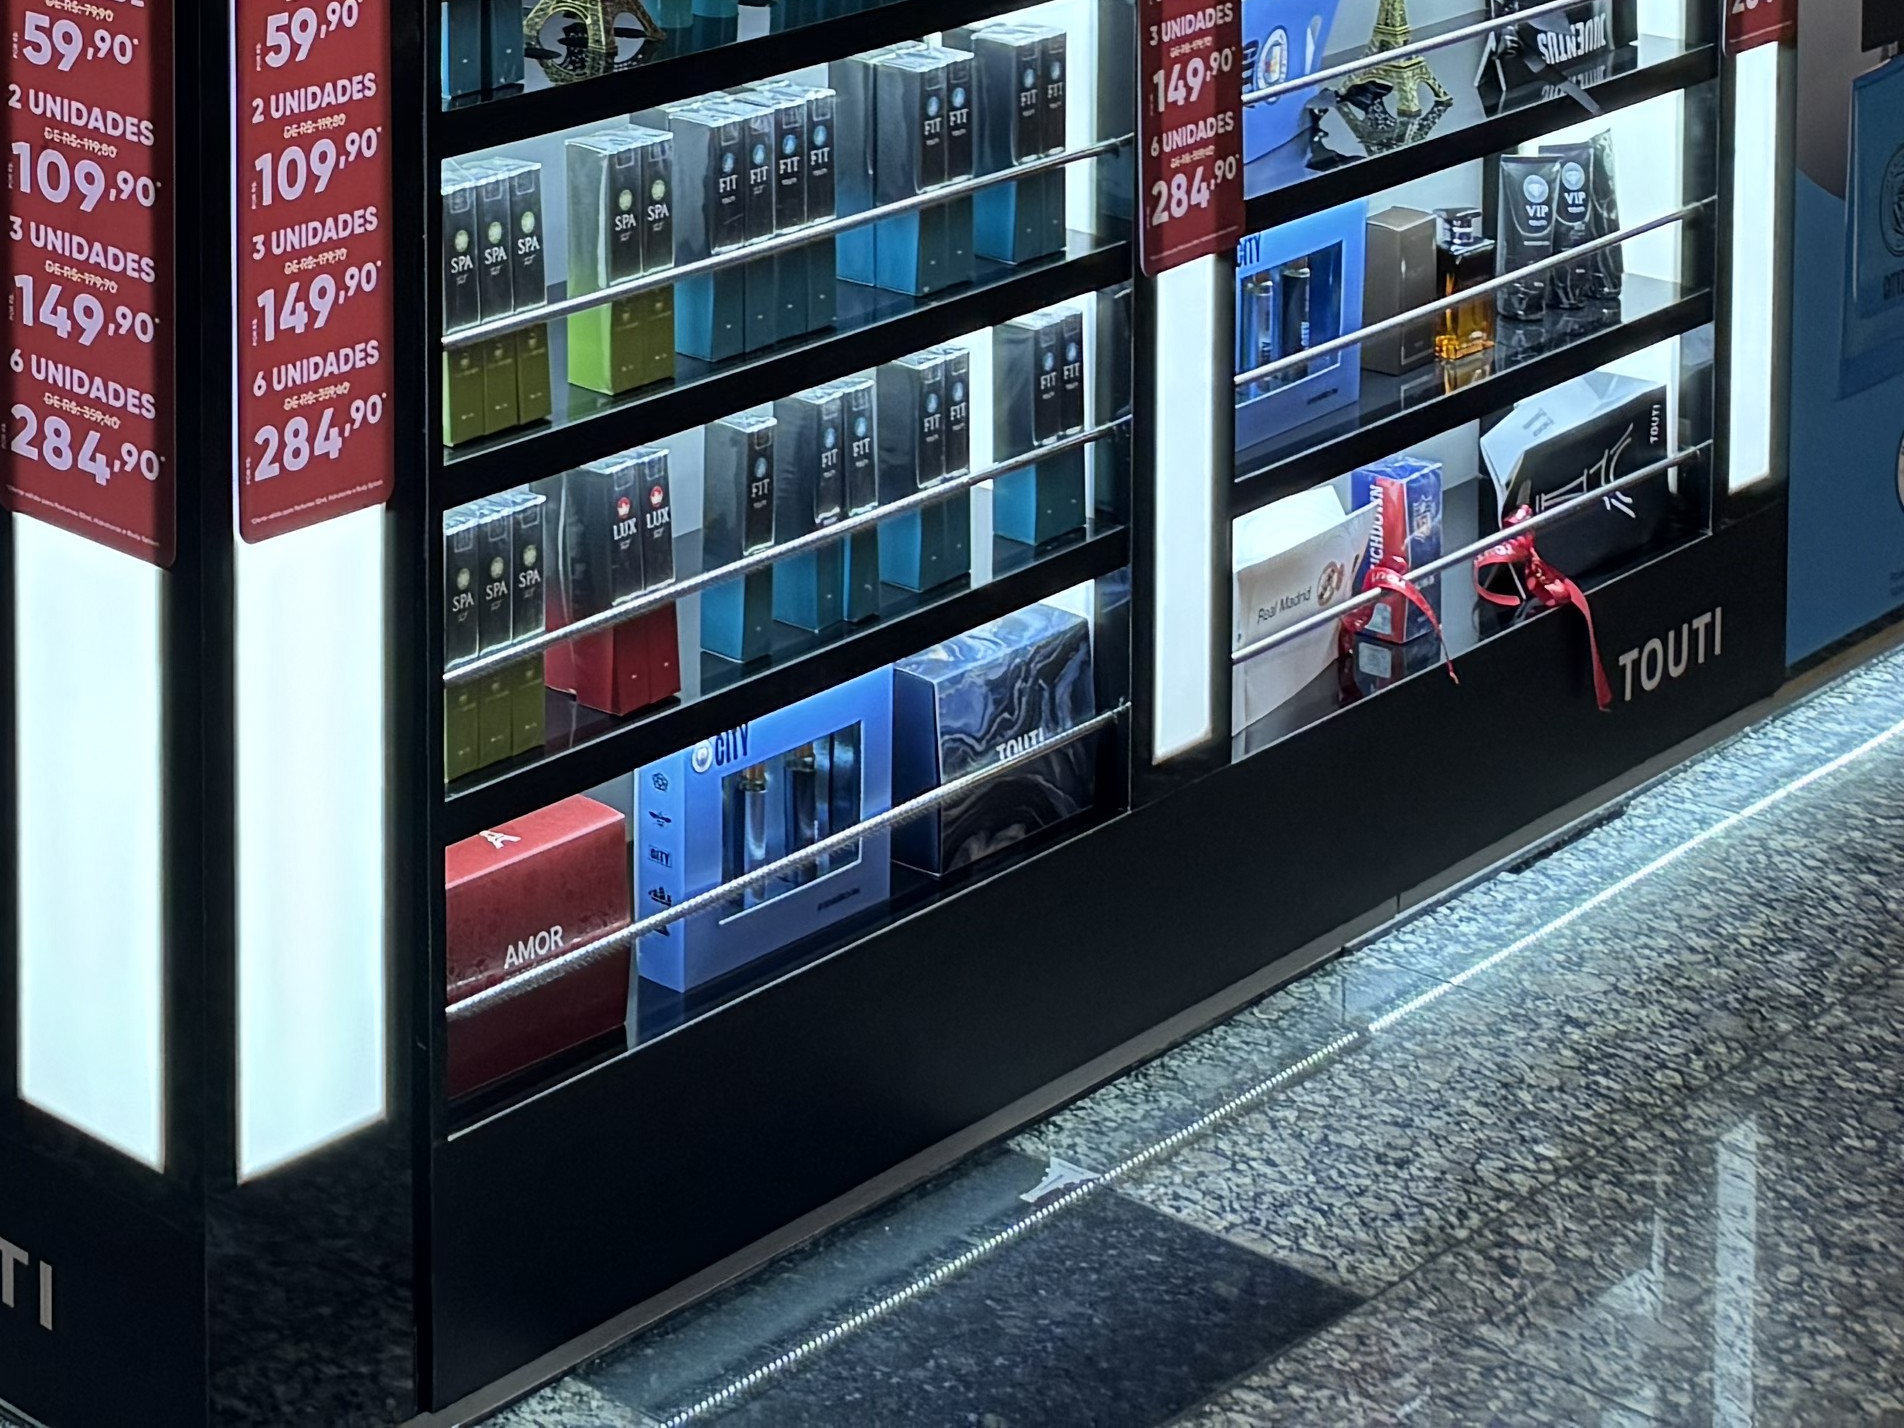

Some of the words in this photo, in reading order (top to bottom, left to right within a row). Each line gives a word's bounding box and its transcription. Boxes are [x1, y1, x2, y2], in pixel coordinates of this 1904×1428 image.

[1149, 26, 1159, 46] 3
[1161, 3, 1233, 43] UNIDADES
[1538, 13, 1607, 65] JUVENTUS
[8, 84, 22, 110] 2
[29, 89, 154, 147] UNIDADES
[251, 99, 265, 125] 2
[270, 72, 377, 119] UNIDADES
[1020, 88, 1038, 108] FIT
[1150, 136, 1159, 157] 6
[1163, 111, 1234, 154] UNIDADES
[779, 155, 800, 176] FIT
[1525, 204, 1550, 219] VIP
[1564, 191, 1586, 207] VIP
[252, 235, 265, 260] 3
[271, 206, 378, 255] UNIDADES
[614, 212, 637, 231] SPA
[8, 215, 23, 240] 3
[30, 221, 156, 283] UNIDADES
[9, 348, 24, 372] 6
[31, 353, 156, 420] UNIDADES
[253, 370, 266, 397] 6
[272, 339, 379, 391] UNIDADES
[1039, 370, 1057, 391] FIT
[1650, 403, 1661, 445] TOUTI
[821, 448, 840, 469] FIT
[613, 518, 638, 541] LUX
[645, 506, 670, 529] LUX
[518, 568, 542, 588] SPA
[1257, 603, 1277, 624] Real
[1279, 587, 1312, 613] Madrid
[1617, 606, 1723, 702] TOUTI
[714, 722, 749, 768] CITY
[503, 924, 565, 971] AMOR
